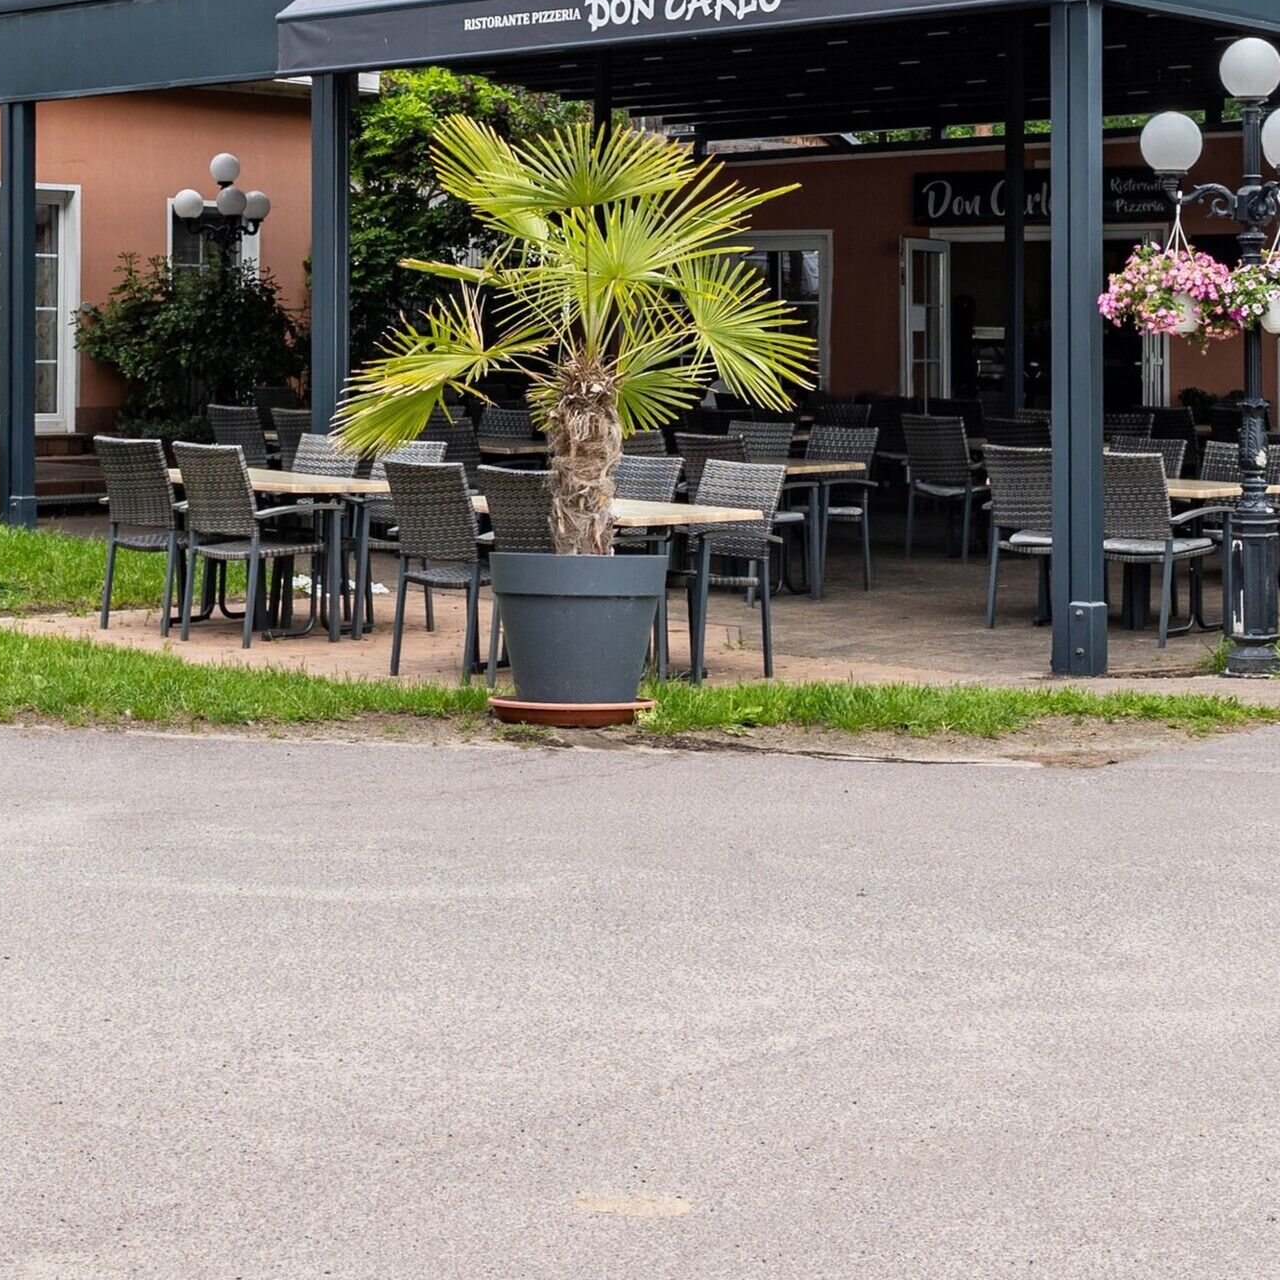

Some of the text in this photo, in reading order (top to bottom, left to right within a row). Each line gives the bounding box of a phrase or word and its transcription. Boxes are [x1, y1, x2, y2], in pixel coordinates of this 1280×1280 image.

[464, 12, 530, 31] RISTORANTE
[531, 7, 581, 25] PIZZERIA
[922, 179, 1052, 218] Don Crl
